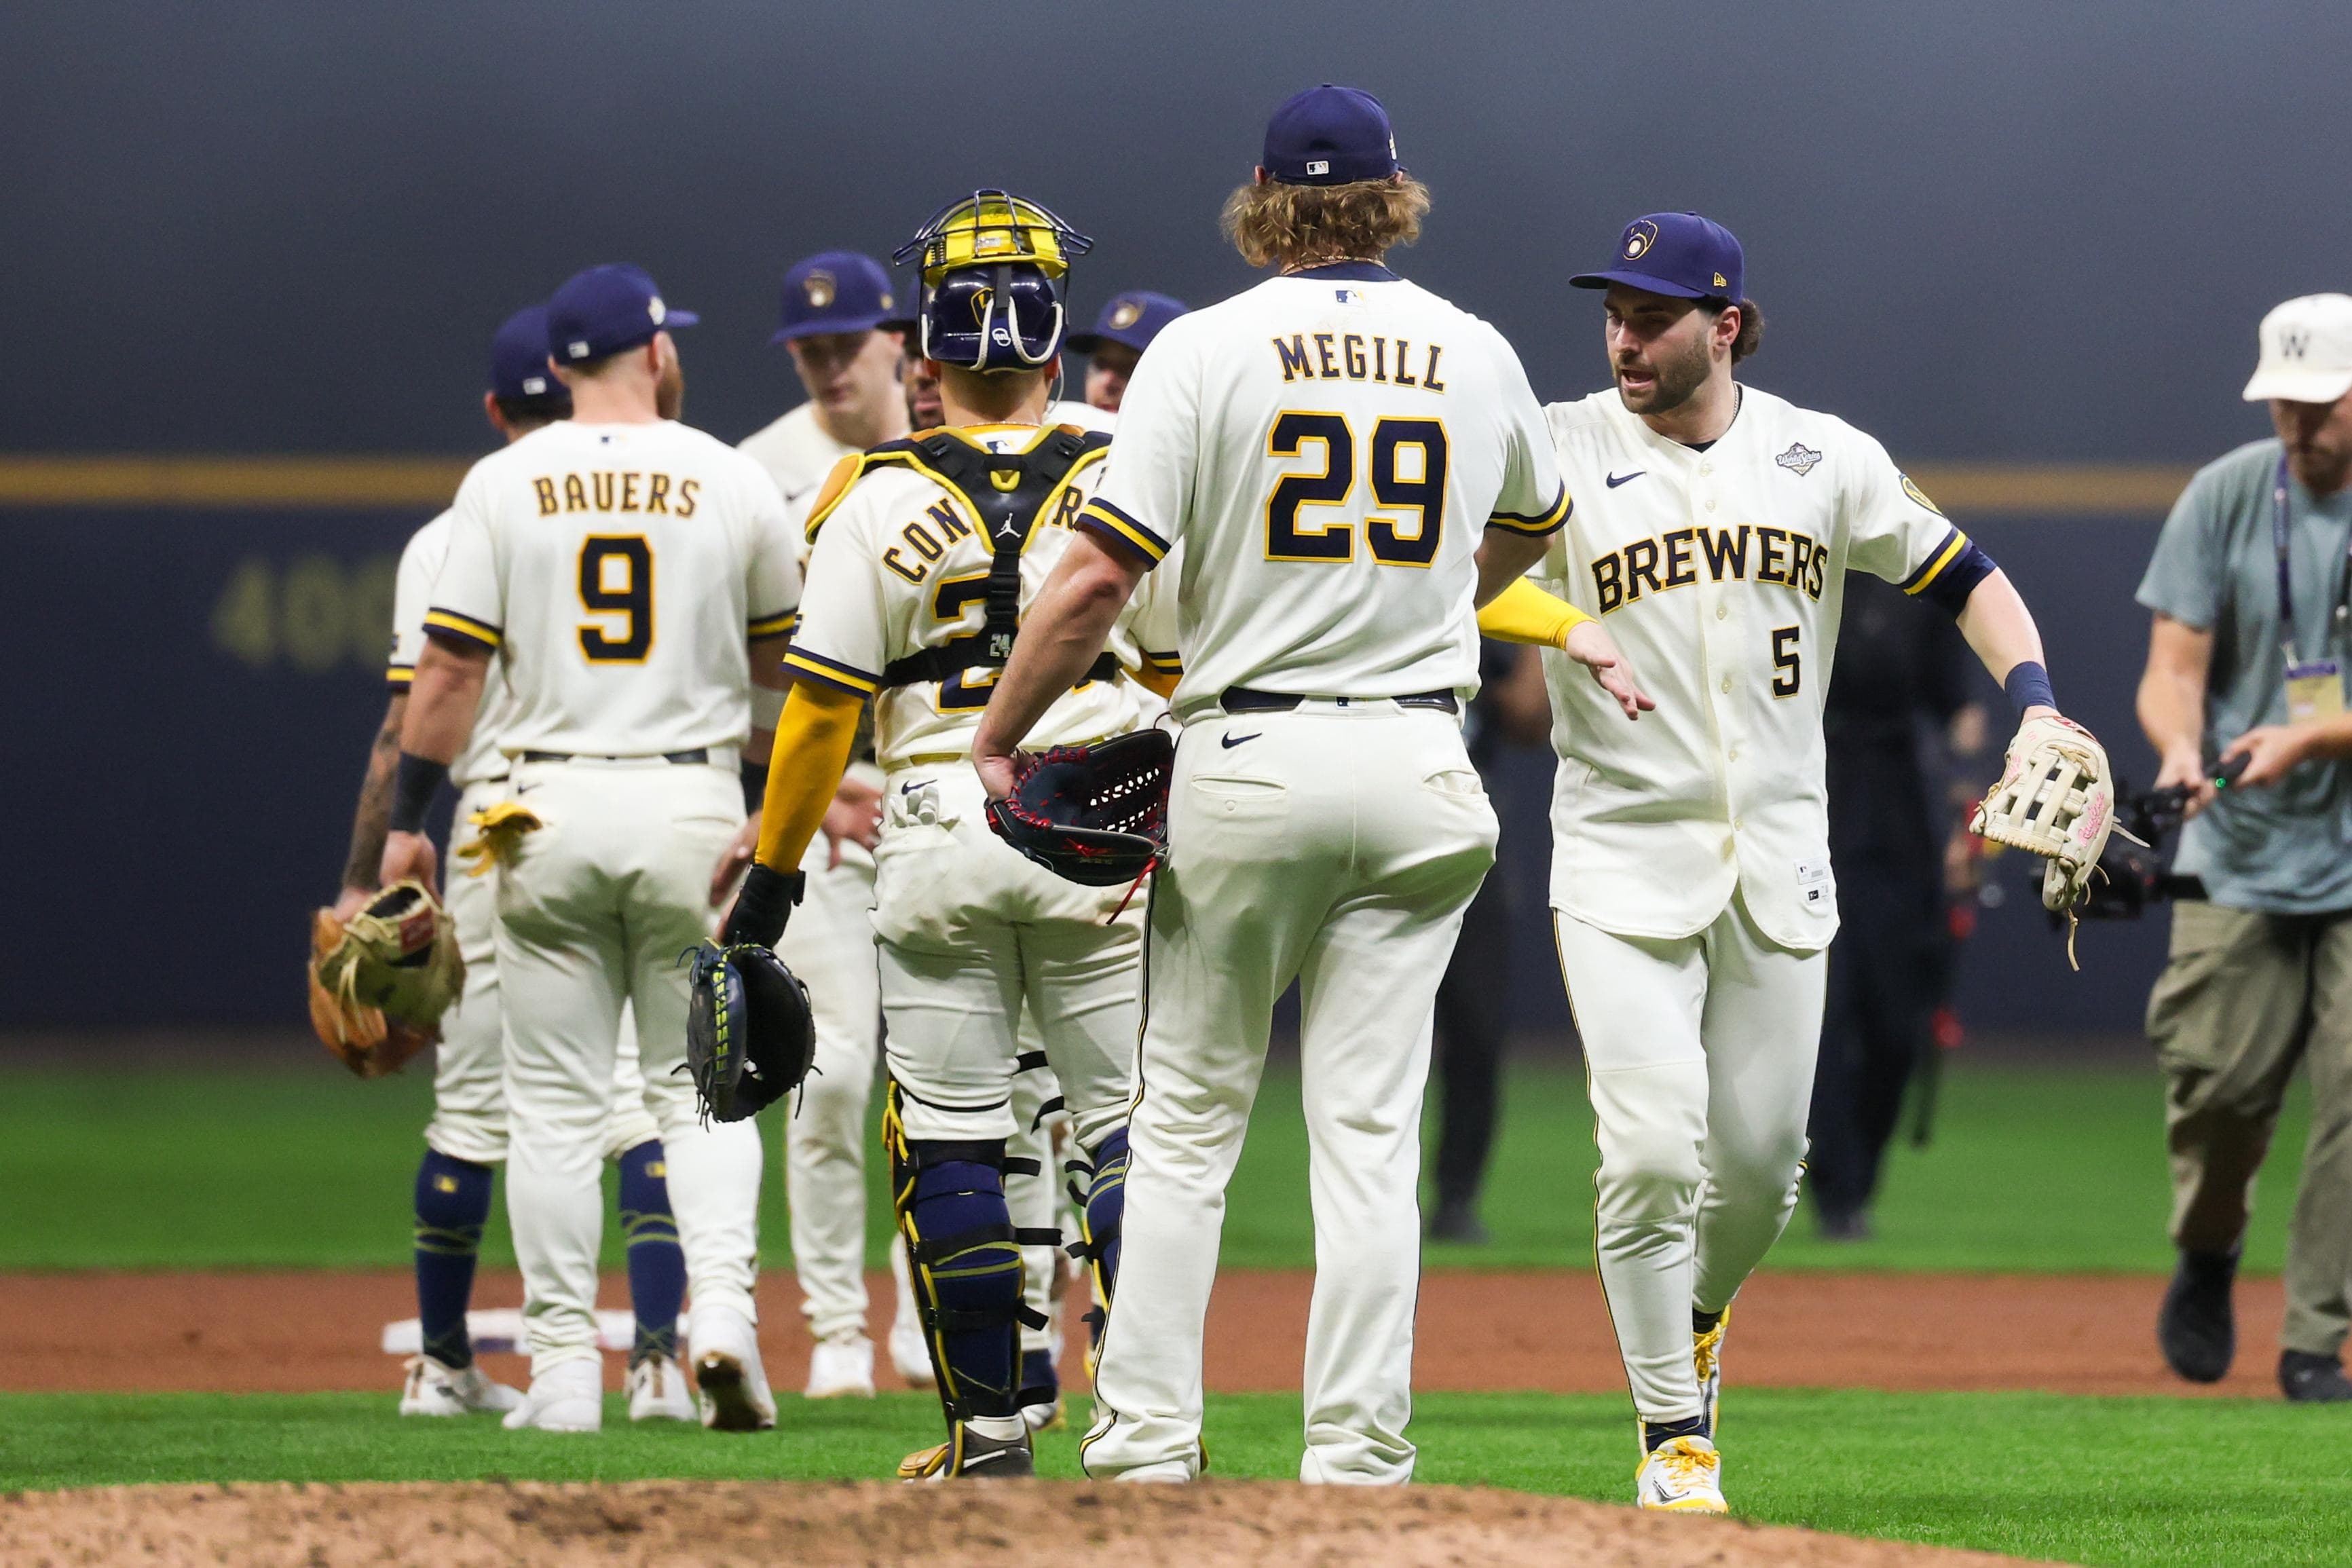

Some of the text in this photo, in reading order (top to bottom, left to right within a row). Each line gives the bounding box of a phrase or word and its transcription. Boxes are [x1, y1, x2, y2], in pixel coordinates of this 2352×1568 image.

[1271, 333, 1447, 395] MEGILL
[2279, 327, 2311, 360] W
[532, 472, 700, 519] BAUERS
[1263, 409, 1450, 569] 29
[576, 534, 654, 665] 9
[1590, 524, 1829, 616] BREWERS
[989, 633, 1011, 658] 24
[1771, 626, 1801, 698] 5
